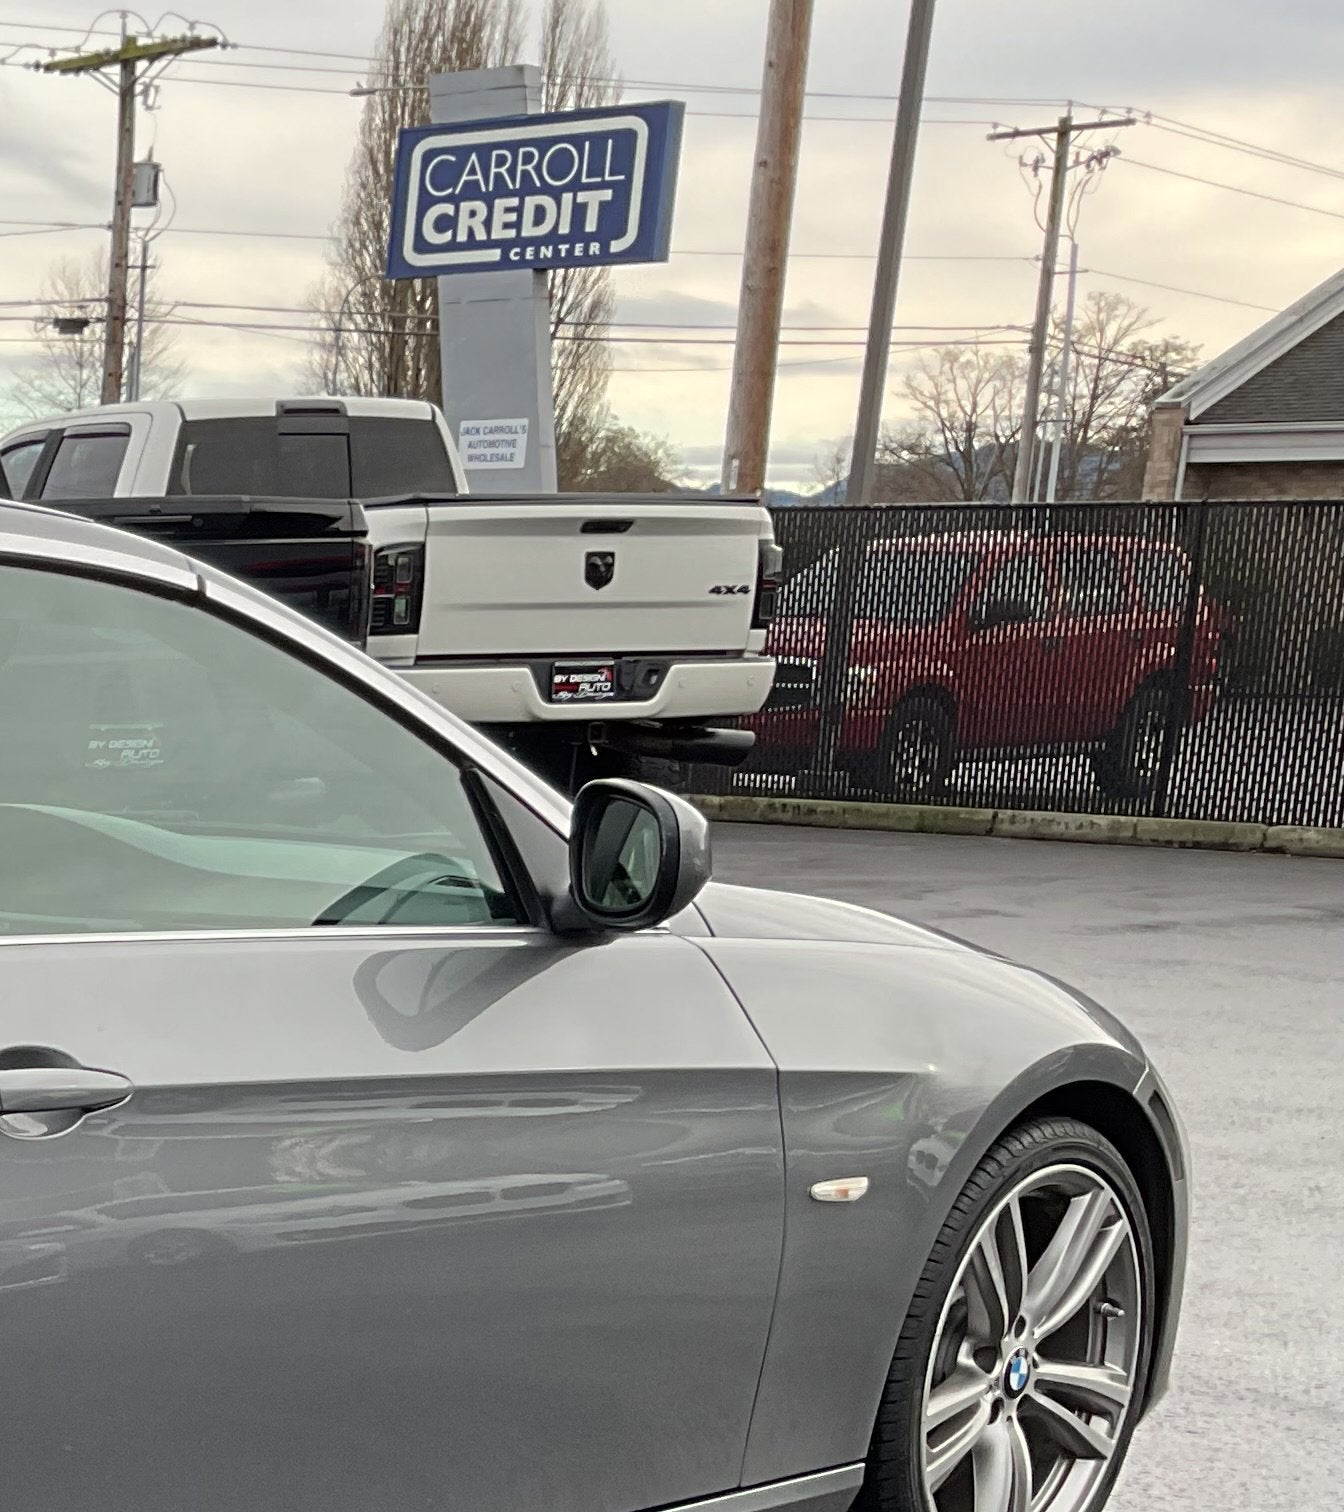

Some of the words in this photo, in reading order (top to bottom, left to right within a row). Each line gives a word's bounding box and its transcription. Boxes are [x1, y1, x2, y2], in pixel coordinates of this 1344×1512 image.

[424, 138, 625, 196] CARROLL
[422, 189, 613, 244] CREDIT
[509, 242, 600, 261] CENTER
[467, 438, 517, 449] AUTOMOTIVE
[467, 452, 515, 463] WHOLESALE
[553, 674, 569, 683] BY
[578, 682, 612, 691] AUTO
